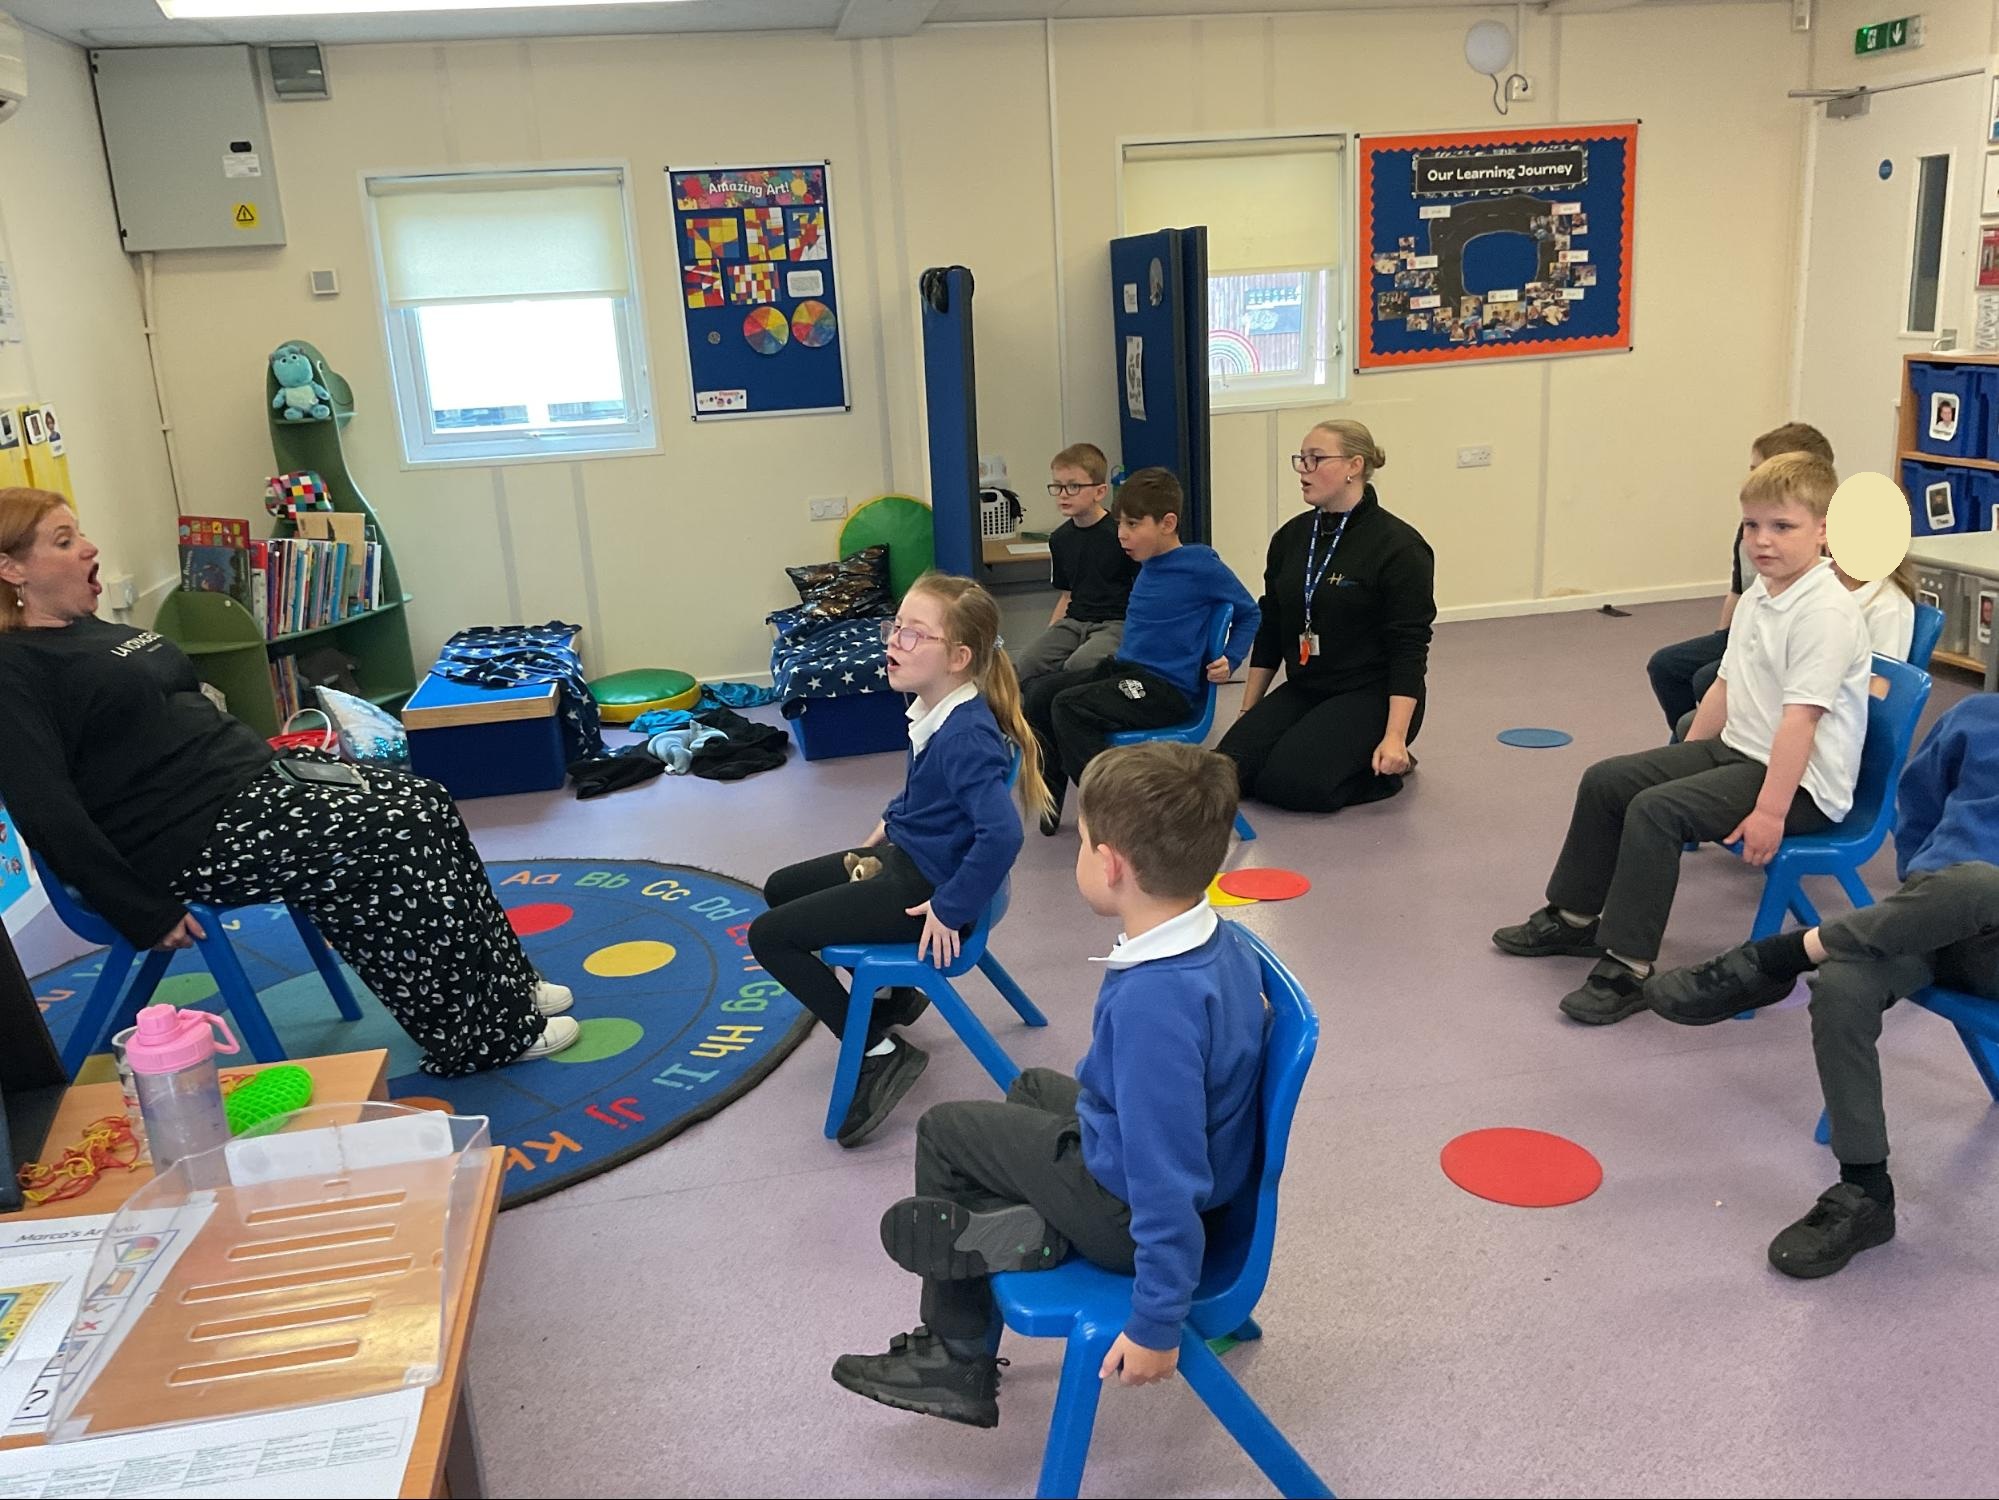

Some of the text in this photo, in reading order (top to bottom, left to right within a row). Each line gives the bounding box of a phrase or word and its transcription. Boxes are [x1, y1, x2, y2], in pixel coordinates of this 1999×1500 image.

[1427, 163, 1573, 181] Our Learning Journey
[709, 181, 790, 197] Amazing Art!
[500, 870, 561, 885] Aa
[574, 871, 631, 888] Bb
[641, 880, 691, 901] Cc
[688, 896, 749, 921] Dd
[720, 980, 787, 1012] Gg
[689, 1025, 764, 1058] Hh
[652, 1063, 720, 1090] Ii
[584, 1097, 645, 1130] Jj
